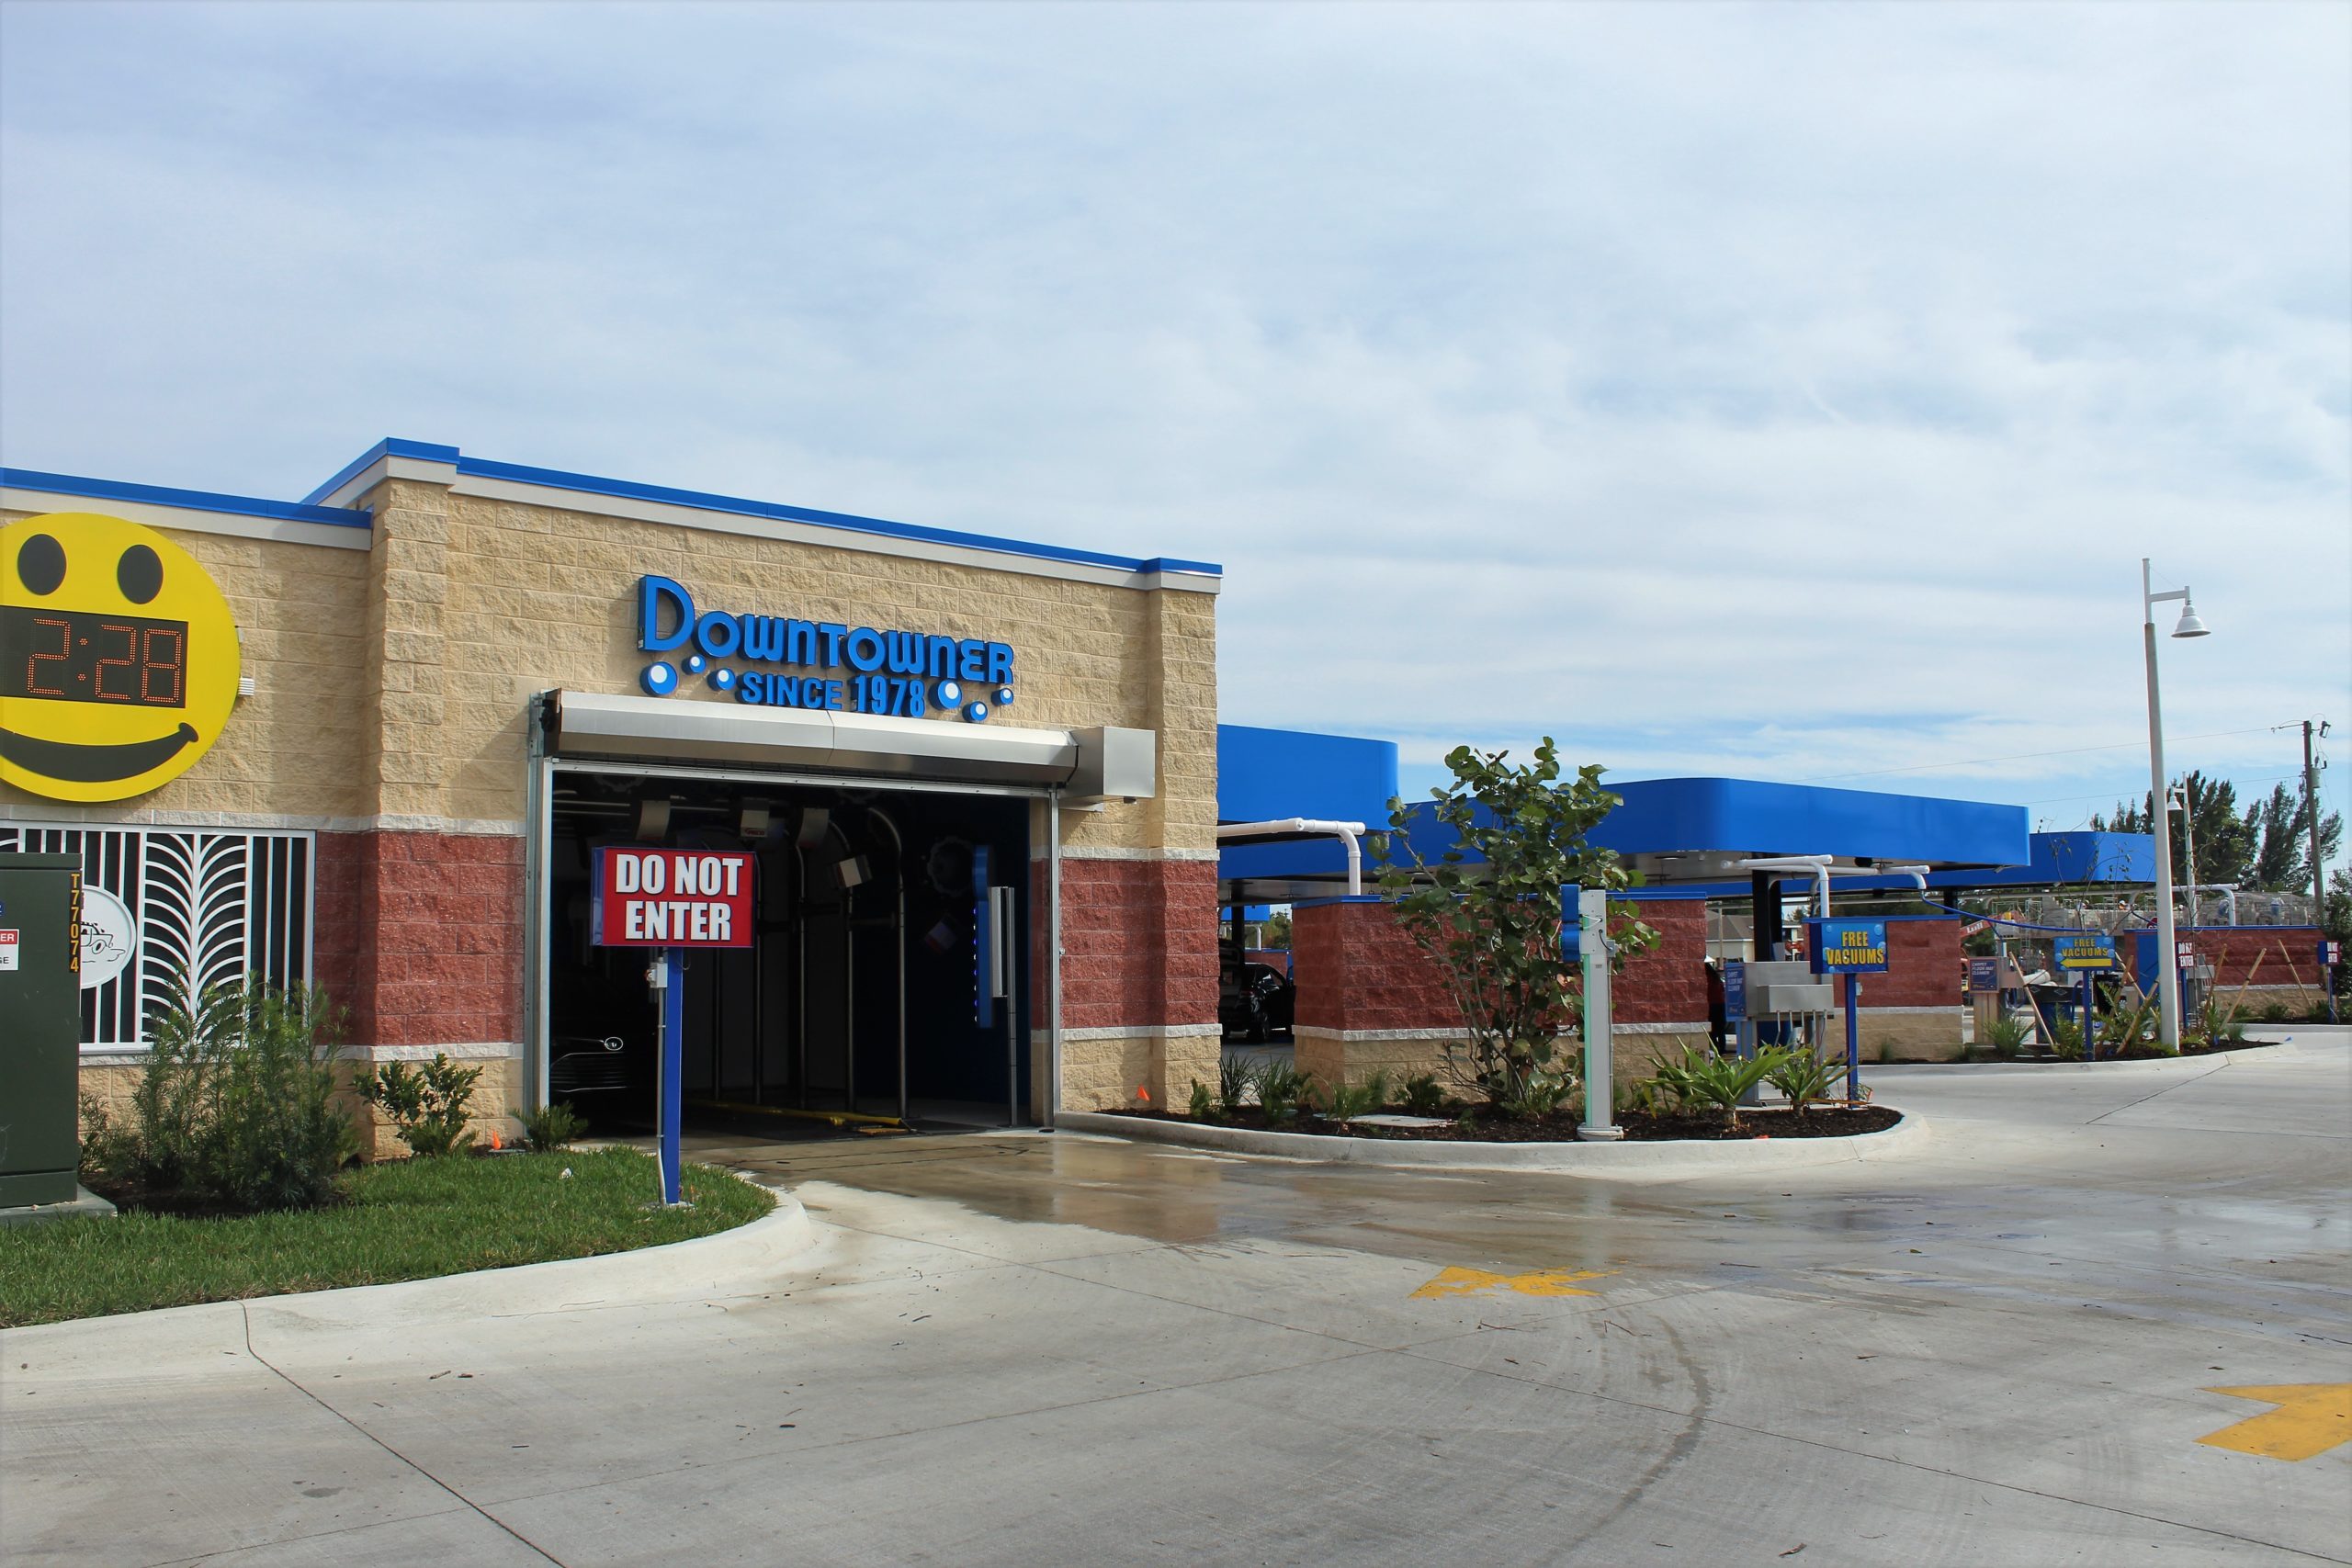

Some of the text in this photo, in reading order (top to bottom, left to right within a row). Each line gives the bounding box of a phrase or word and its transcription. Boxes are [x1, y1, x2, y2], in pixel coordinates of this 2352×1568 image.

[27, 617, 182, 704] 2:28
[736, 671, 926, 717] SINCE 1978
[616, 853, 743, 896] DO NOT
[71, 874, 80, 972] T77074
[626, 900, 731, 941] ENTER
[1841, 931, 1869, 947] FREE
[1826, 948, 1884, 964] VACUUMS
[2062, 947, 2109, 956] VACUUMS
[2074, 938, 2096, 947] FREE
